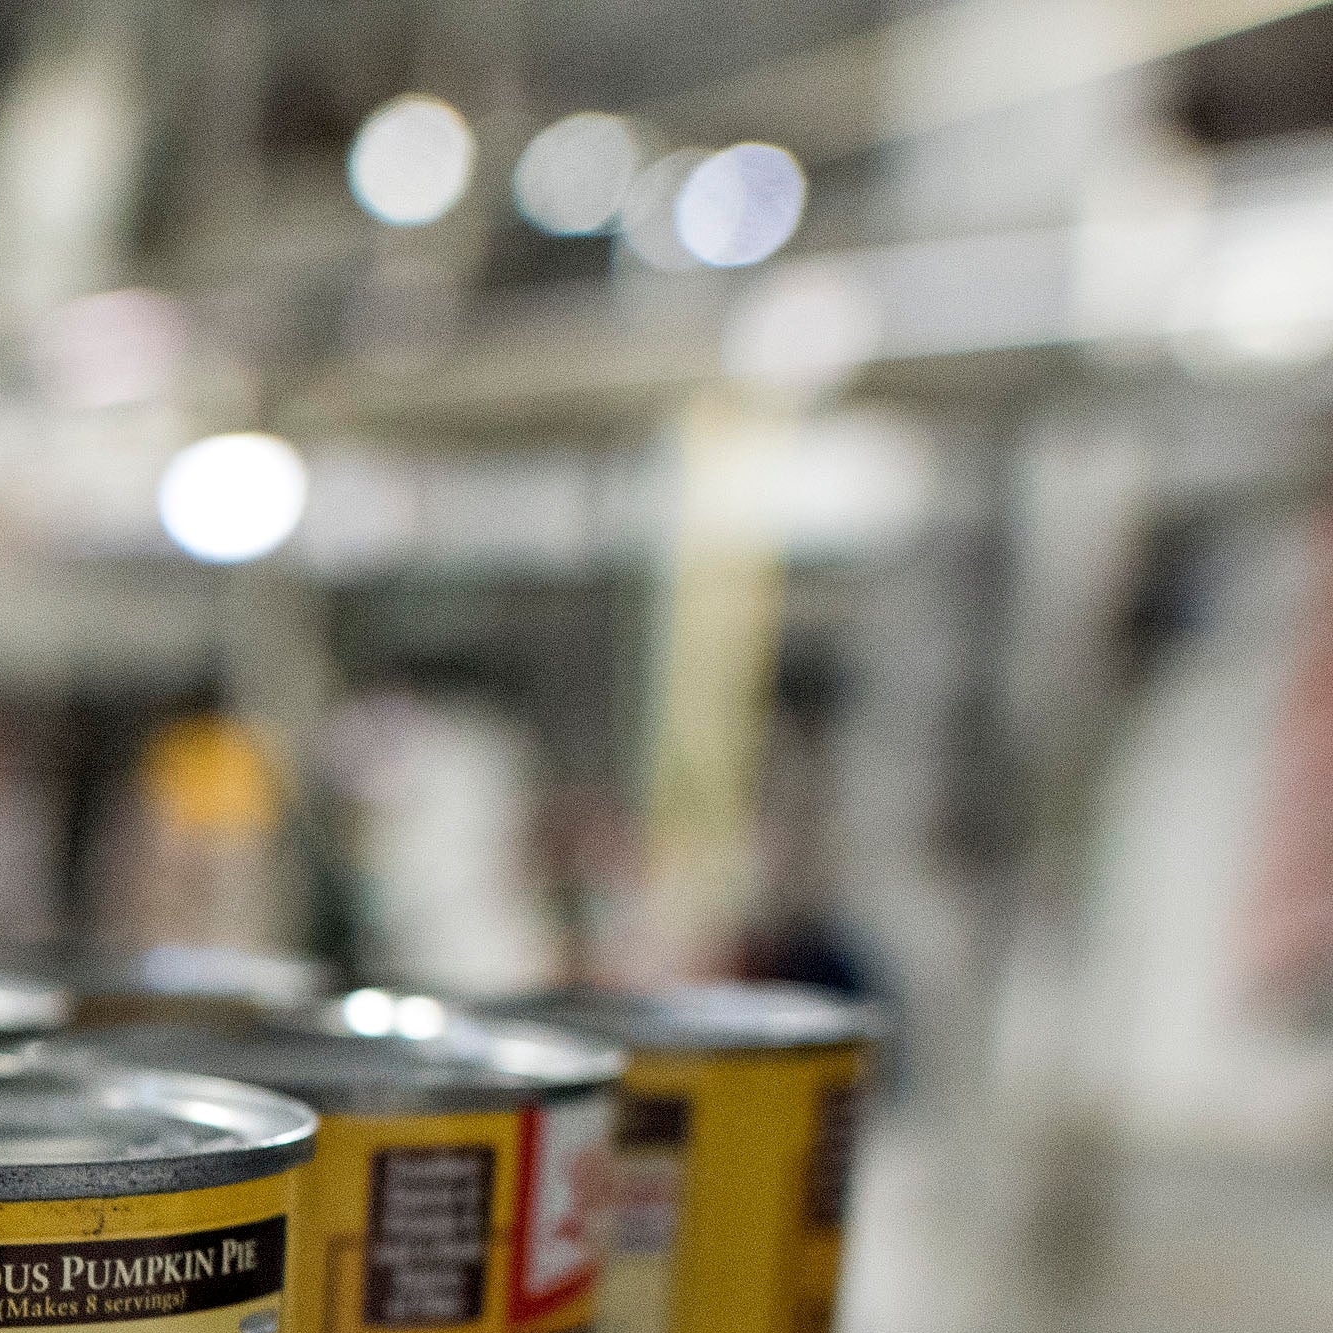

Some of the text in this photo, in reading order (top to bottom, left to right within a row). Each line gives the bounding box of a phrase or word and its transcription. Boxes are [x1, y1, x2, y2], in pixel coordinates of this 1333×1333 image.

[60, 1248, 216, 1293] PUMPKIN
[220, 1239, 257, 1276] PIE
[84, 1293, 98, 1315] 8
[103, 1288, 188, 1314] servings)
